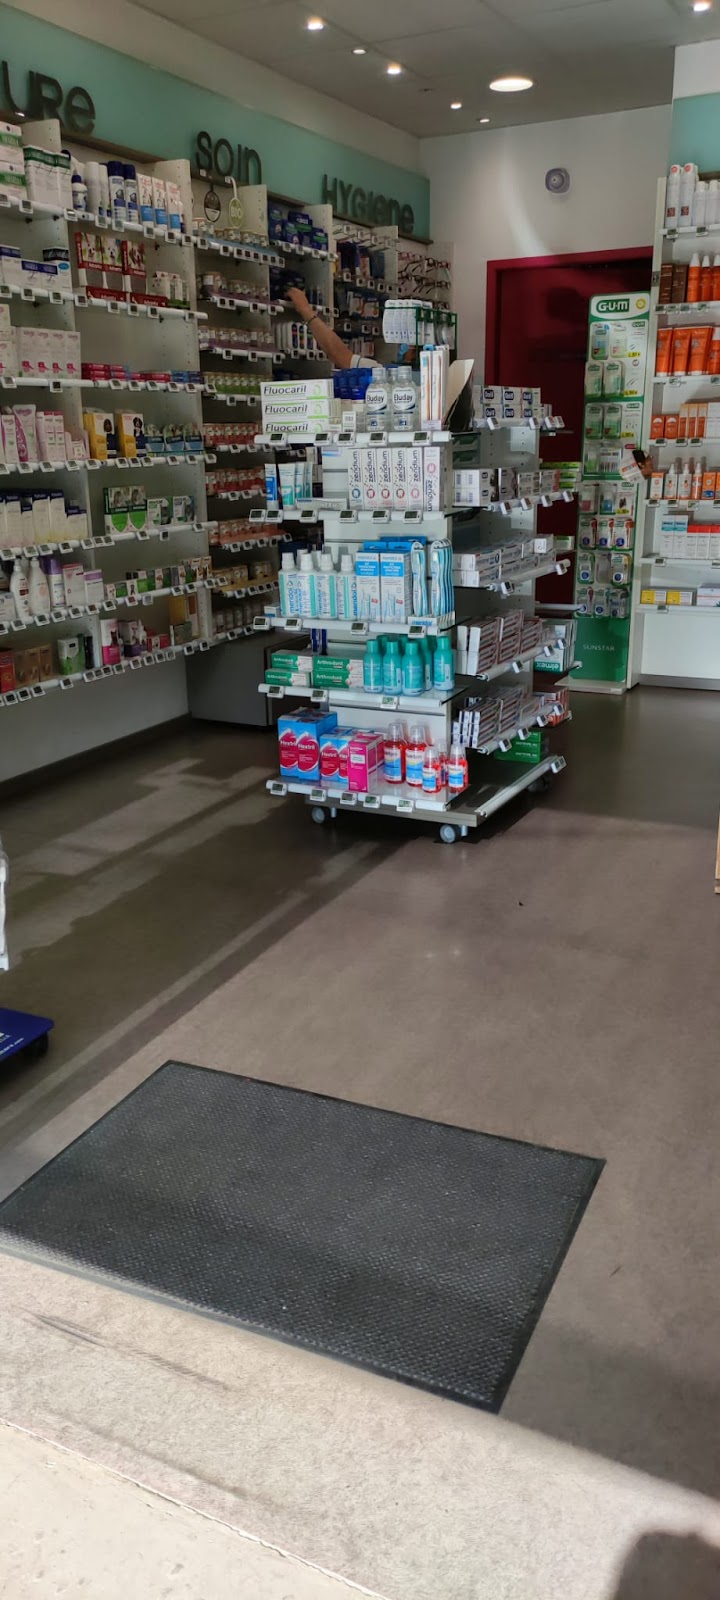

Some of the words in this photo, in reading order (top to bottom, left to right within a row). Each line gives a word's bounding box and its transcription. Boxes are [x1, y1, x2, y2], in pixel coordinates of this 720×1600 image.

[264, 385, 307, 394] Fluocaril
[265, 404, 308, 413] Fluocaril
[266, 423, 308, 432] Fluocaril
